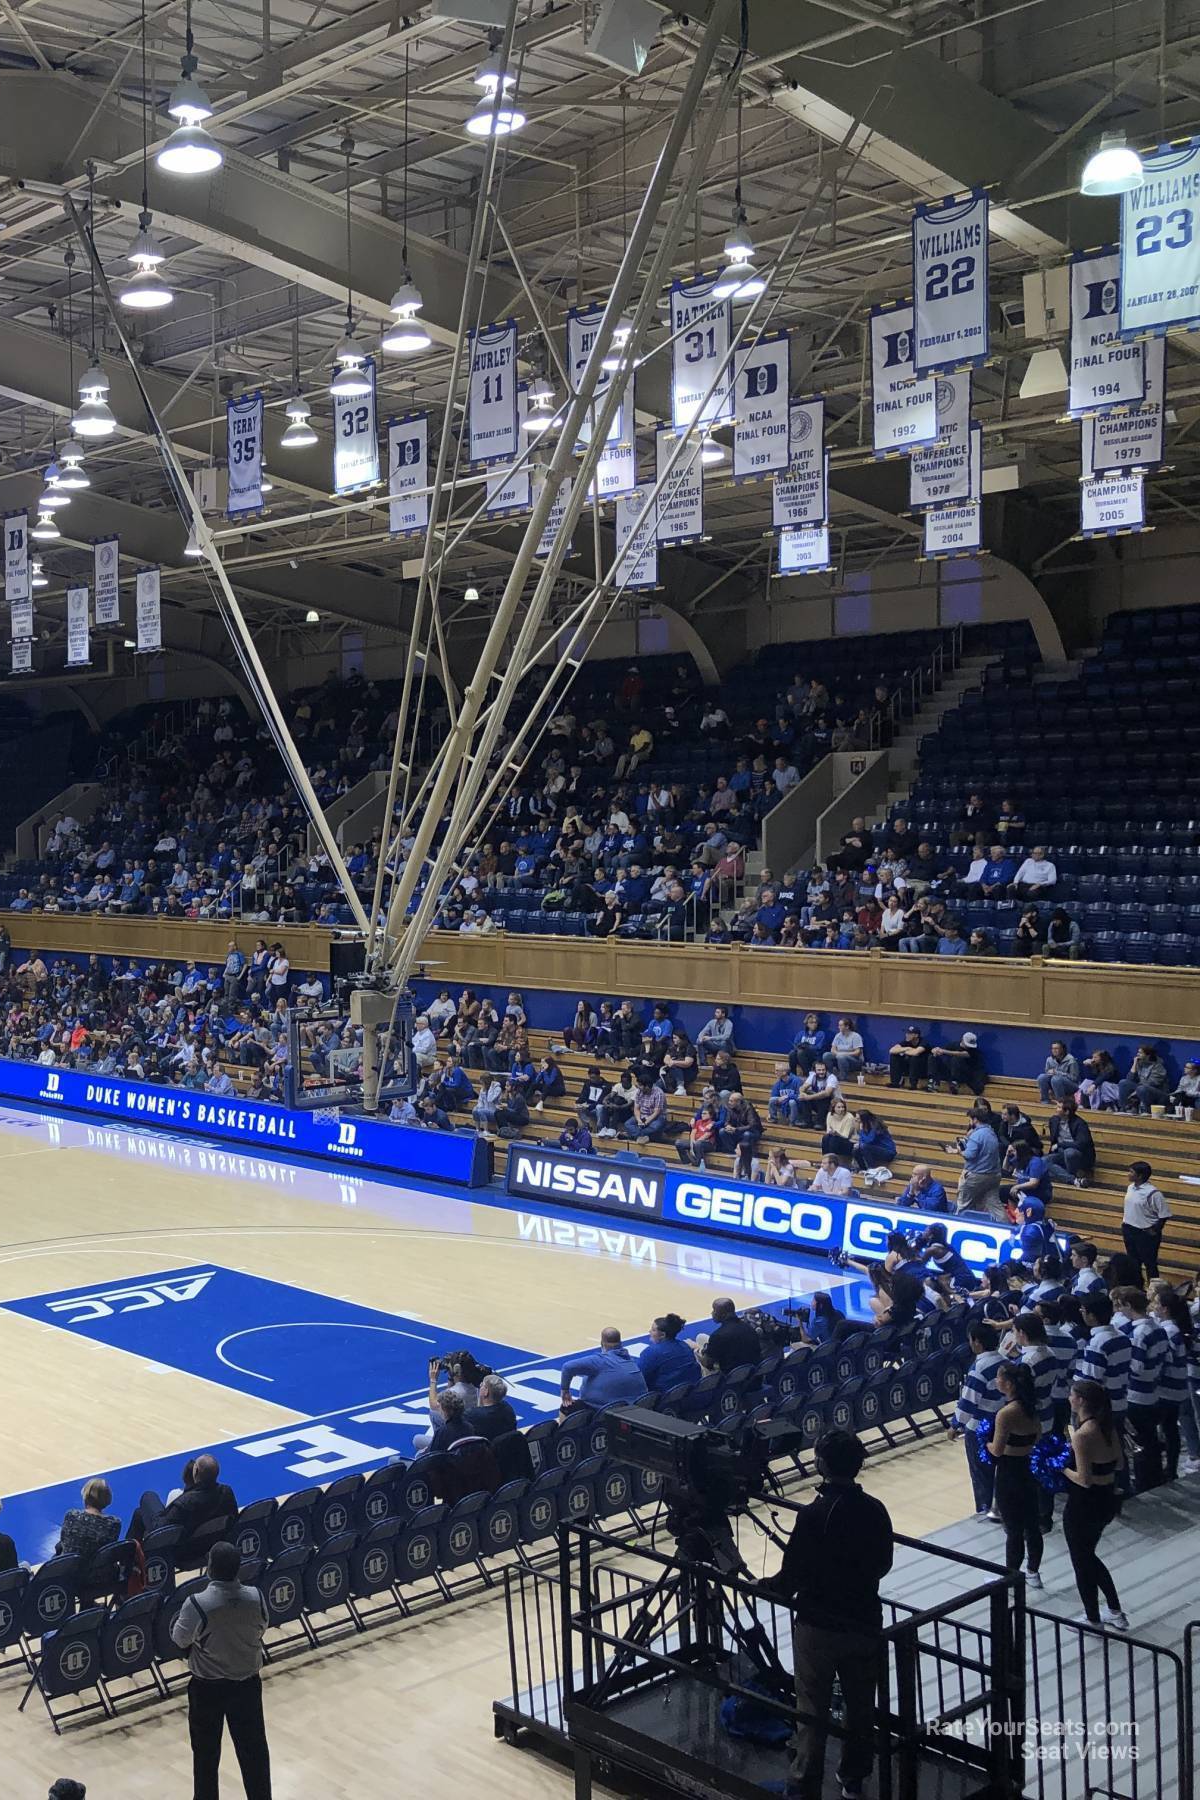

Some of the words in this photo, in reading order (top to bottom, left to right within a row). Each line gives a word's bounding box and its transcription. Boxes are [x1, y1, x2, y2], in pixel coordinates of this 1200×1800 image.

[1130, 173, 1200, 212] WILLIAMS
[1135, 208, 1194, 257] 23
[919, 224, 981, 260] WILLIAMS
[925, 256, 975, 301] 22
[1127, 291, 1164, 307] JANUARY
[684, 326, 718, 363] 31
[919, 333, 956, 348] FEBRUARY
[1090, 331, 1121, 347] NCAA
[473, 346, 511, 373] HURLEY
[1073, 353, 1105, 370] FINAL
[1108, 347, 1141, 362] FOUR
[482, 373, 504, 405] 11
[1091, 382, 1121, 397] 1994
[876, 399, 903, 414] FINAL
[906, 392, 933, 406] FOUR
[341, 406, 369, 438] 32
[749, 409, 773, 423] NCAA
[233, 415, 258, 436] FERRY
[736, 428, 760, 441] FINAL
[761, 424, 786, 436] FOUR
[892, 424, 916, 438] 1992
[1099, 417, 1158, 435] CHAMPIONS
[233, 436, 256, 464] 35
[610, 449, 632, 460] FOUR
[913, 445, 967, 462] CONFERENCE
[1114, 447, 1142, 460] 1979
[751, 453, 771, 465] 1991
[914, 457, 965, 474] CHAMPIONS
[400, 477, 416, 488] NCAA
[775, 481, 819, 496] CHAMPIONS
[1087, 482, 1138, 498] CHAMPIONS
[930, 507, 976, 522] CHAMPIONS
[1099, 510, 1125, 521] 2005
[670, 521, 688, 532] 1965
[785, 529, 824, 542] CHAMPIONS
[942, 533, 964, 544] 2004
[86, 1084, 120, 1107] DUKE
[127, 1092, 191, 1119] WOMEN'S
[197, 1101, 297, 1138] BASKETBALL
[516, 1157, 659, 1209] NISSAN
[675, 1182, 834, 1242] GEICO
[47, 1272, 216, 1323] ACC
